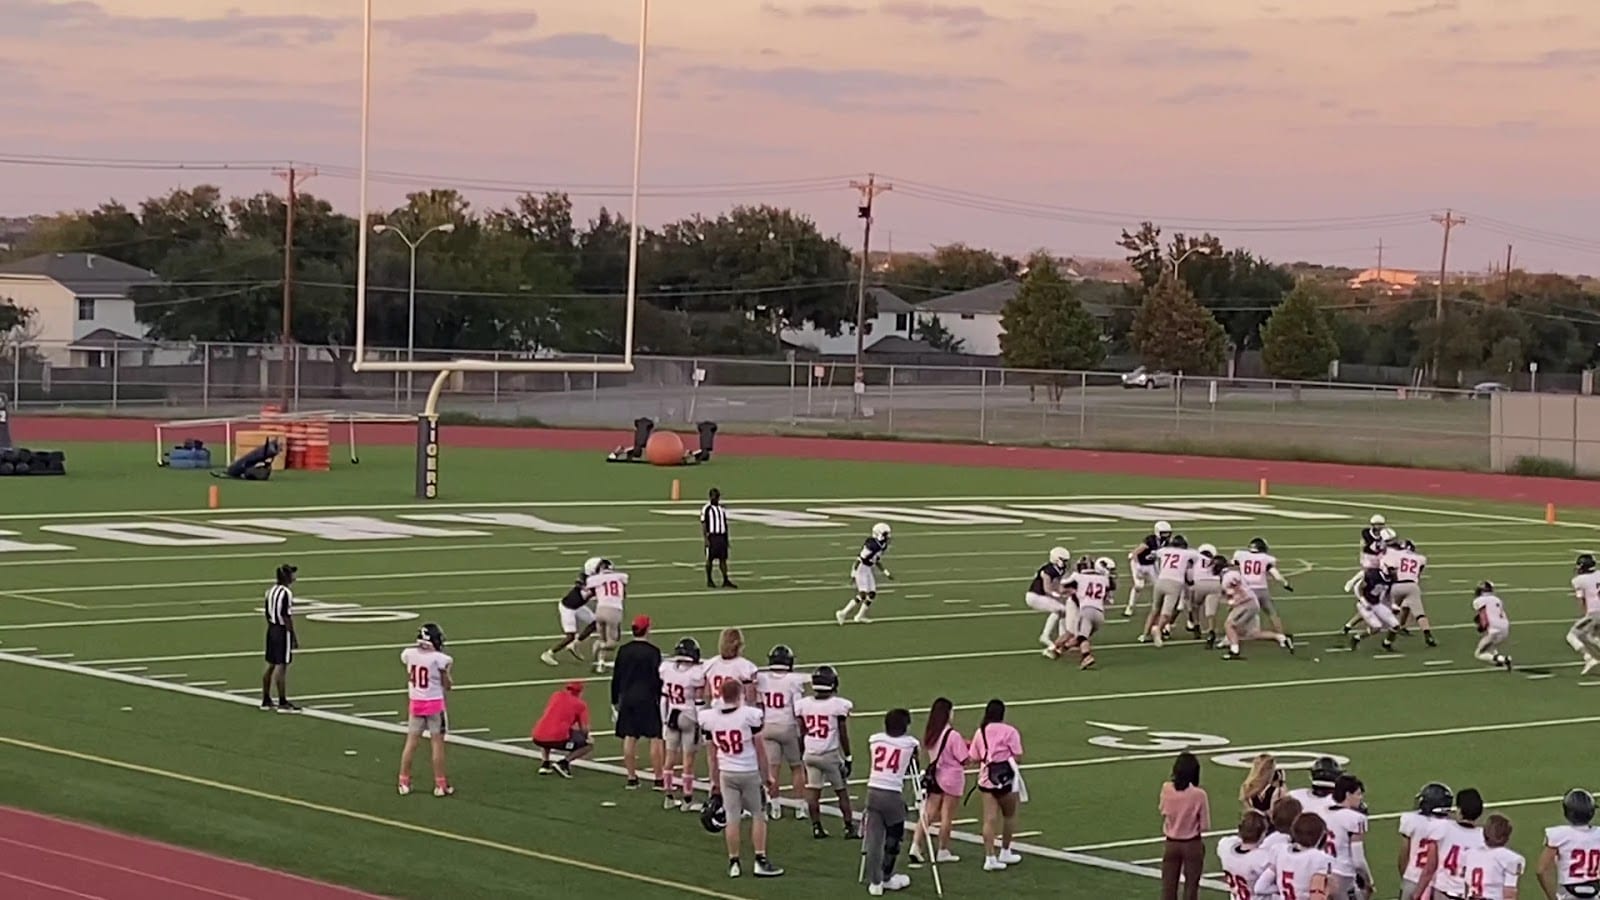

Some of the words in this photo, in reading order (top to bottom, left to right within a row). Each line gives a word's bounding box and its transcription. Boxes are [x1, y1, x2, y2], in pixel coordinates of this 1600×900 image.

[1163, 553, 1180, 569] 72
[1243, 560, 1262, 575] 60
[1400, 558, 1417, 574] 62
[603, 580, 619, 597] 18
[1085, 582, 1103, 600] 42
[666, 682, 686, 704] 13
[764, 692, 785, 709] 10
[806, 715, 829, 739] 25
[715, 729, 744, 755] 58
[873, 746, 901, 774] 24
[1568, 848, 1600, 878] 20
[1282, 871, 1297, 900] 5
